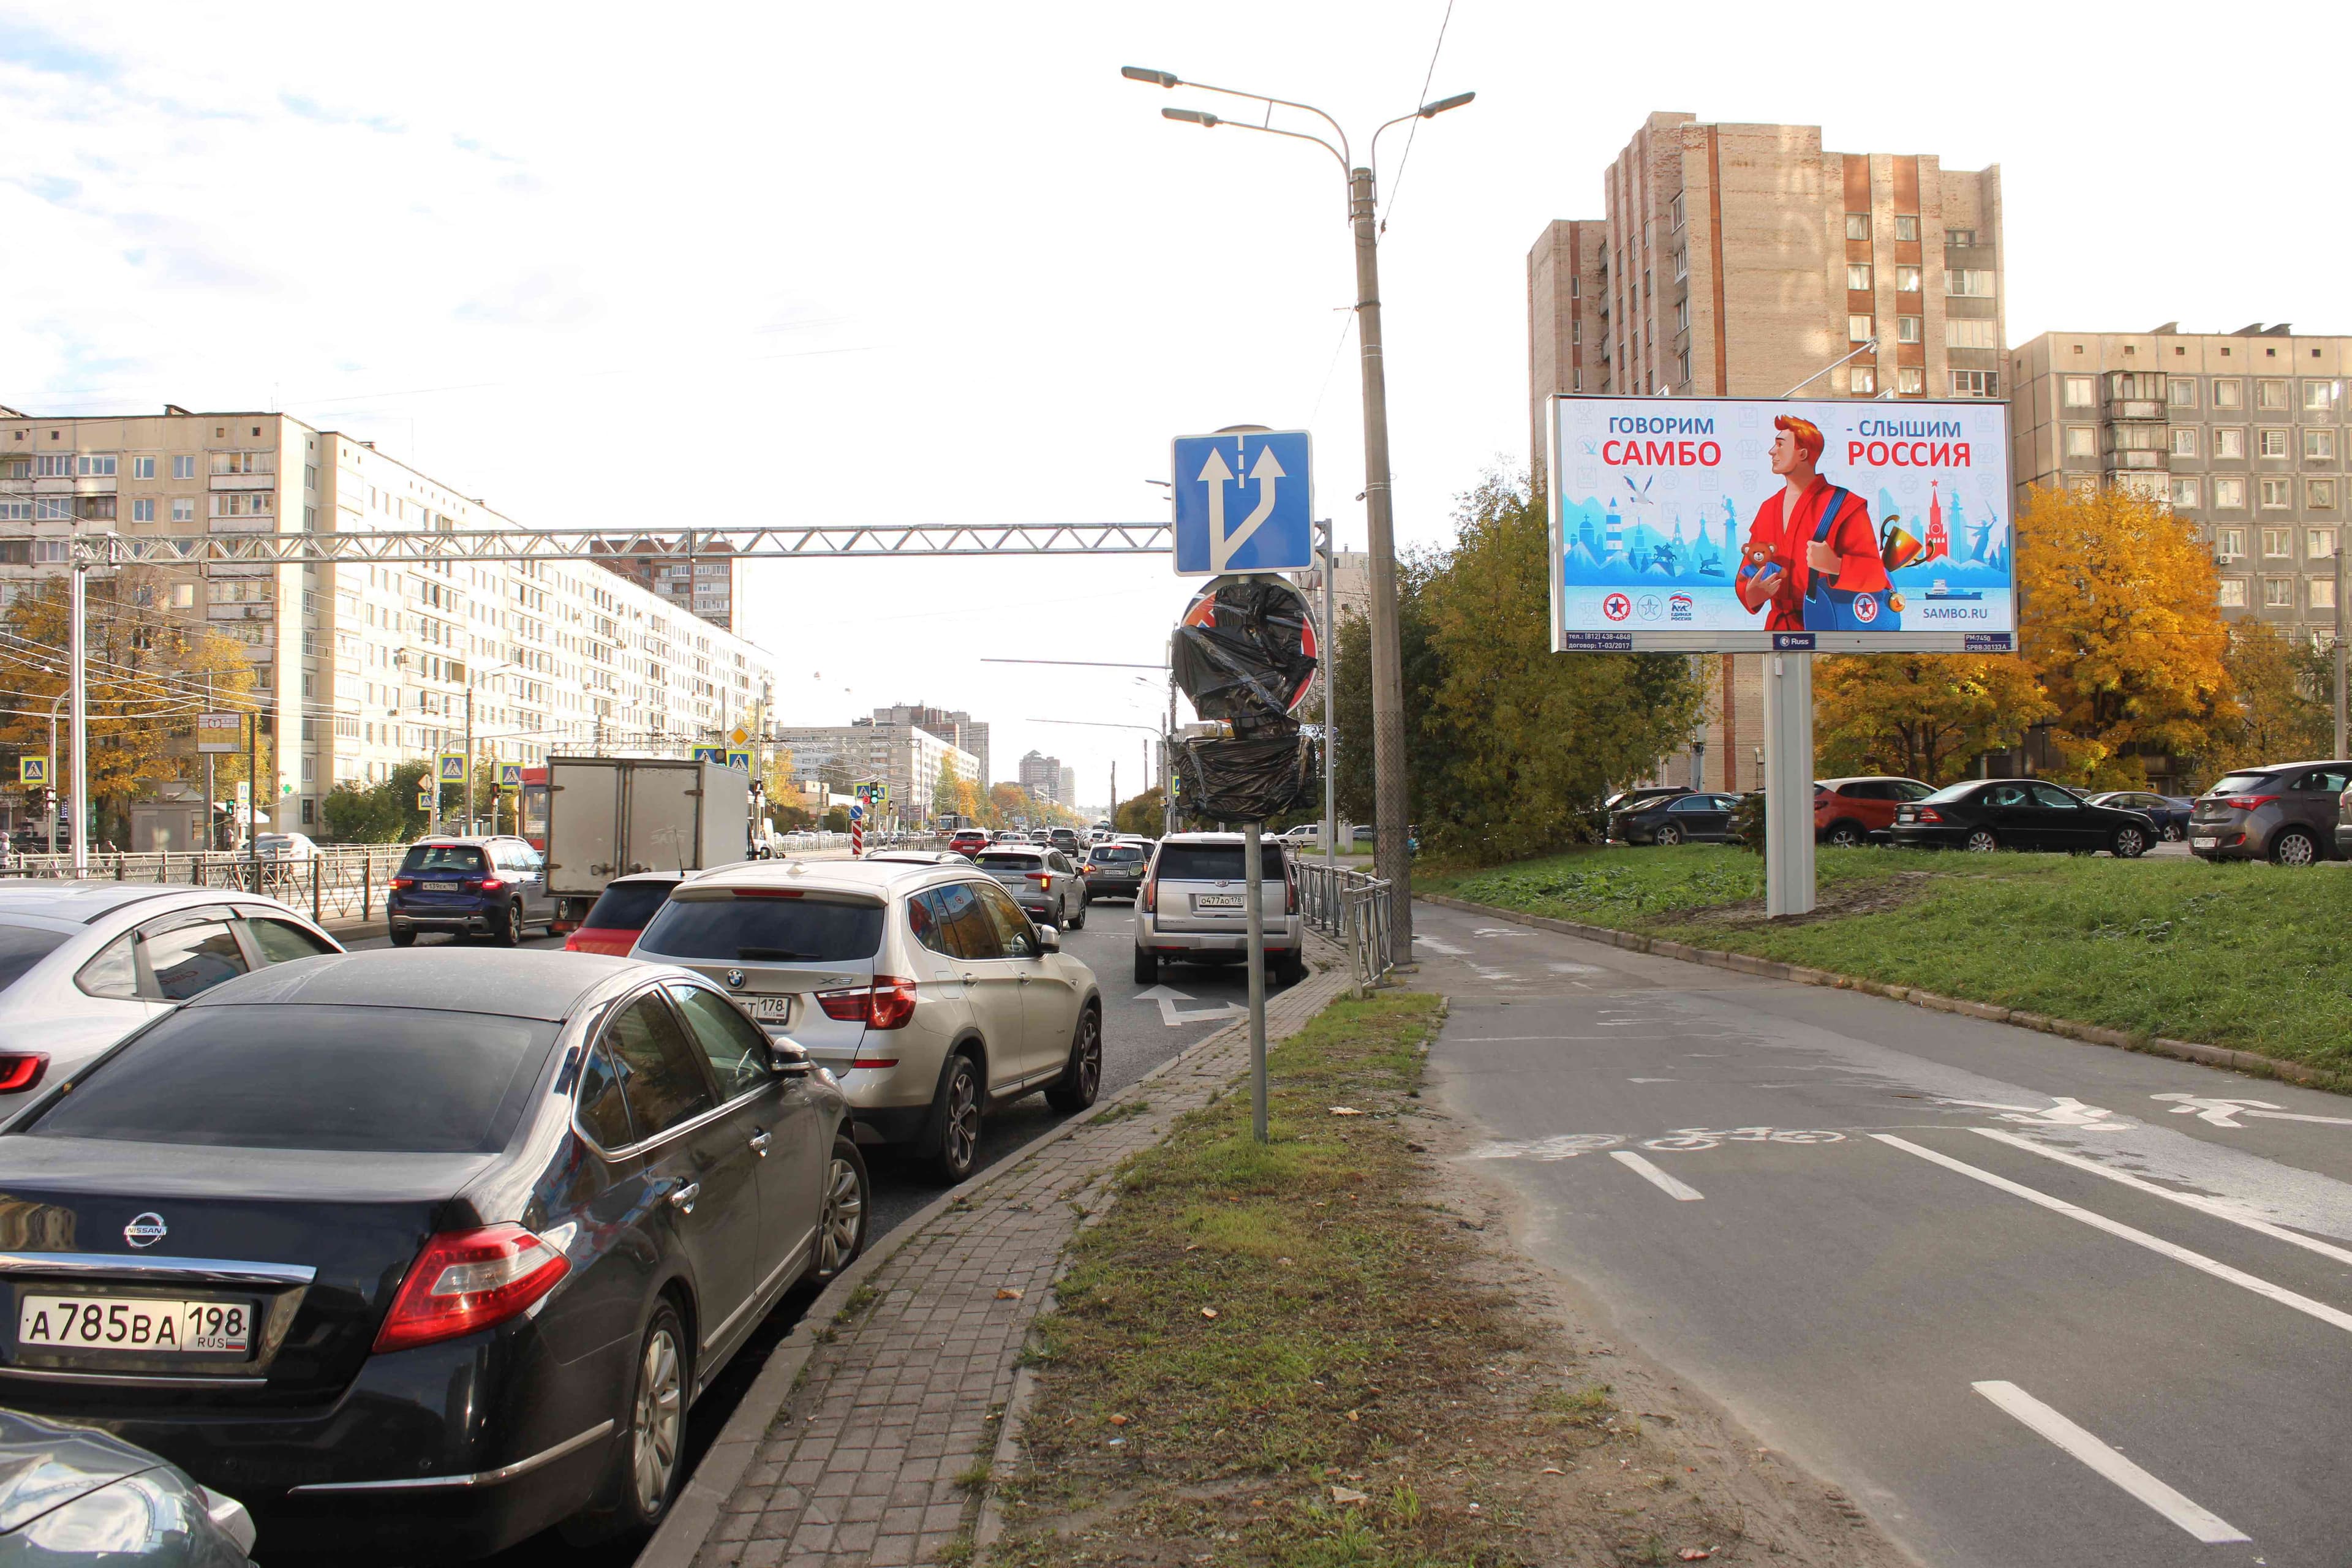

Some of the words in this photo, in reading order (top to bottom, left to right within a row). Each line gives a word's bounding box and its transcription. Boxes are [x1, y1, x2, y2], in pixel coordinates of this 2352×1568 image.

[1609, 417, 1714, 435] ГОВОРИМ
[1858, 420, 1961, 438] СЛЫШИМ
[1602, 440, 1722, 467] САМБО
[1848, 441, 1970, 467] РОССИЯ
[1923, 608, 1988, 619] SAMBO.RU
[1791, 637, 1809, 646] Russ
[760, 999, 783, 1012] 178
[29, 1303, 176, 1346] А785ВА
[188, 1306, 243, 1336] 198
[197, 1336, 225, 1349] RUS
